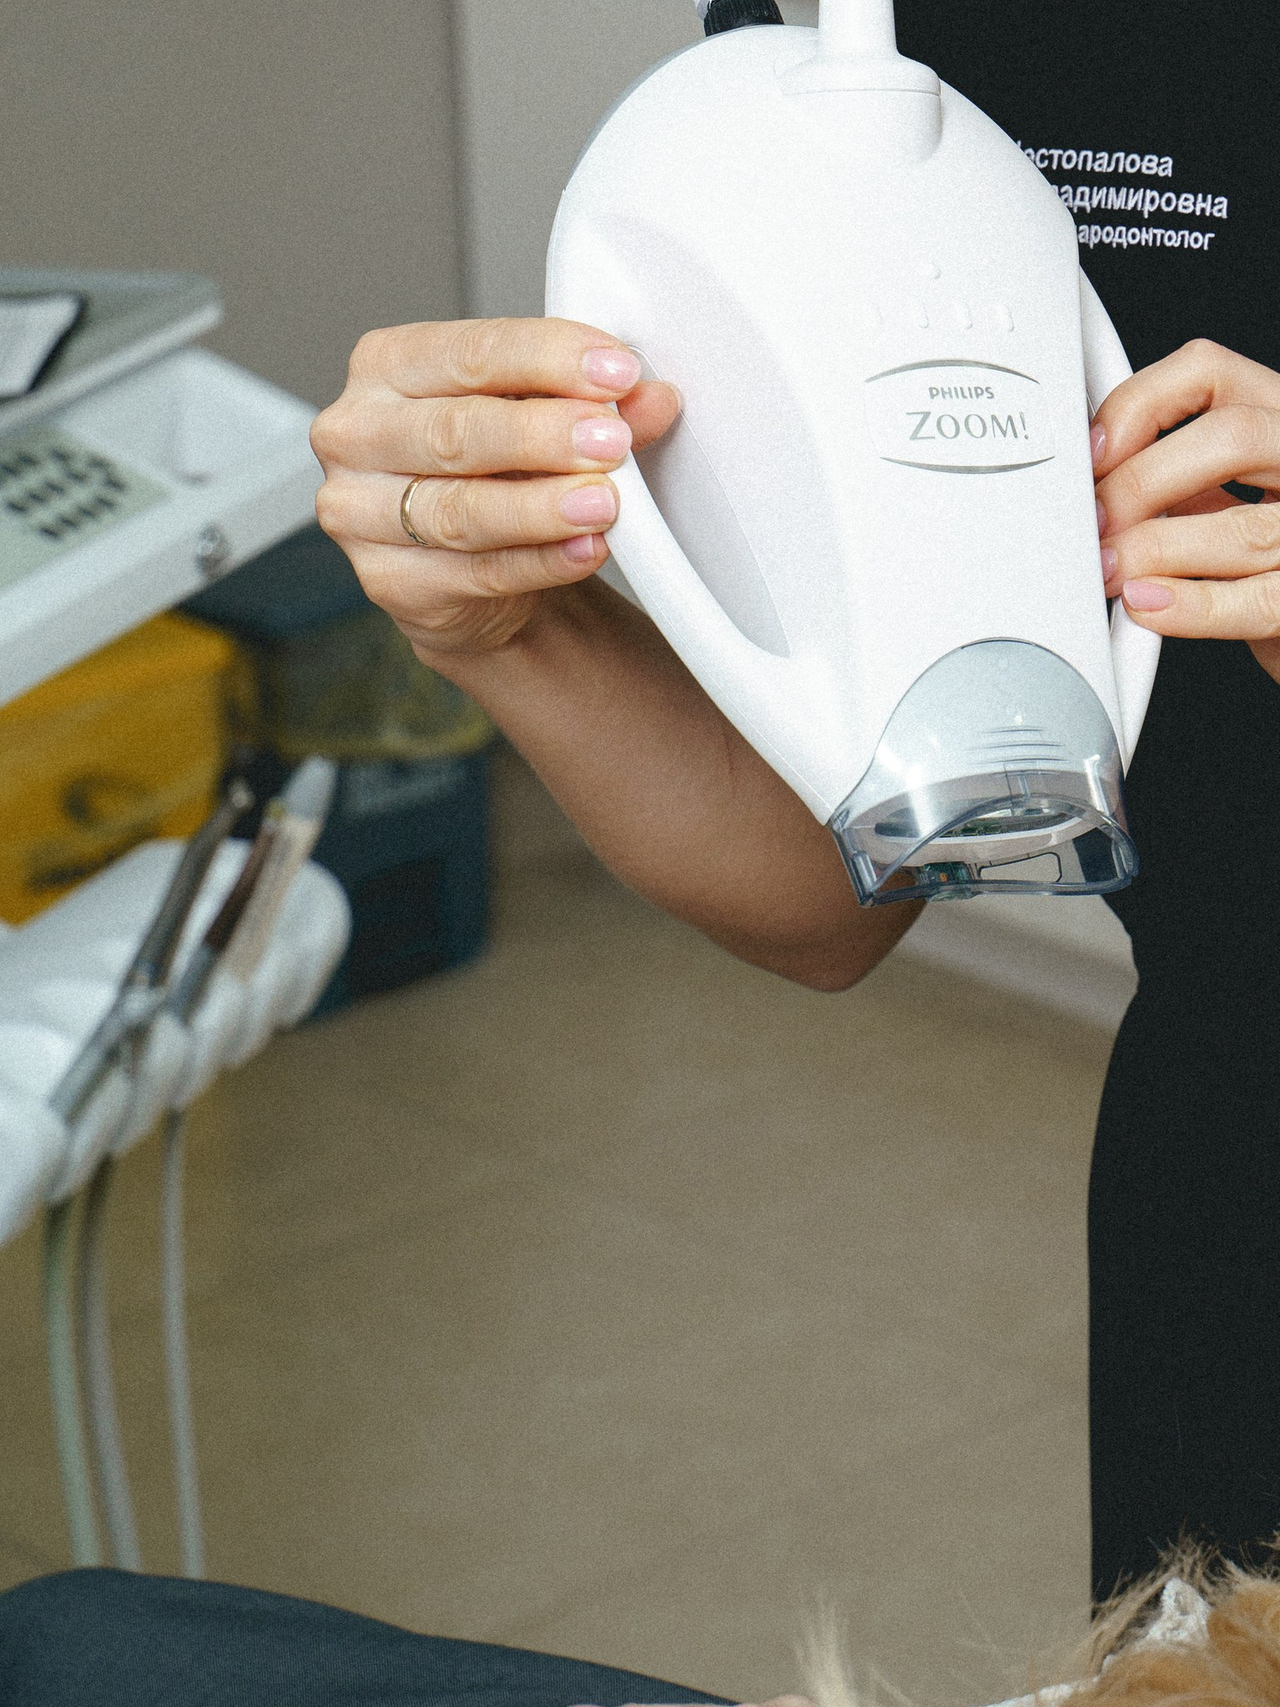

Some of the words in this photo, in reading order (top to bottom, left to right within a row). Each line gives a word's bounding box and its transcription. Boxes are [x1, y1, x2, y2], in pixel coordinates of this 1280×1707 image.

[1017, 140, 1173, 177] стопалова
[1052, 183, 1227, 218] адимировна
[1077, 223, 1214, 250] ародонтолог
[928, 386, 995, 400] PHILIPS
[906, 411, 1029, 441] ZOOM!
